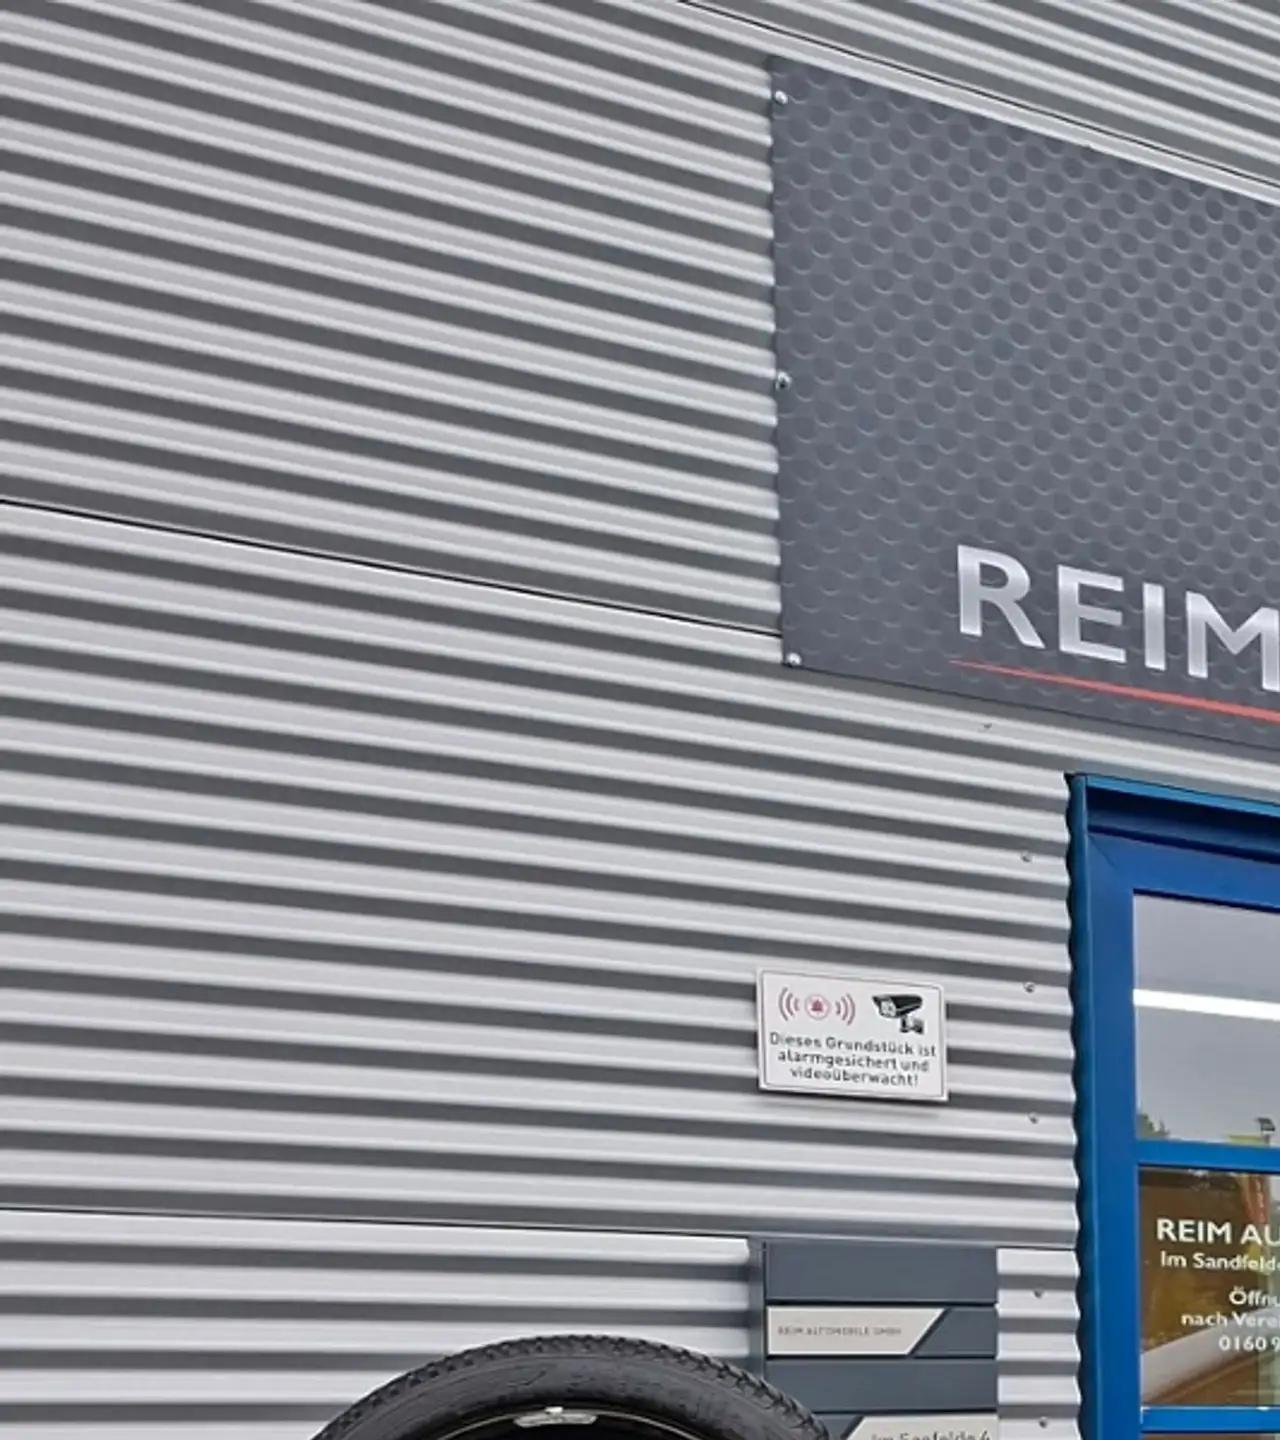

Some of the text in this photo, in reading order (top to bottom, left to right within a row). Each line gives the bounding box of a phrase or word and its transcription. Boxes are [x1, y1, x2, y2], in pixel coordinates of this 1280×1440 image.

[769, 1031, 937, 1058] Dieses Grundstück ist
[777, 1050, 930, 1073] alarmgesichert und
[790, 1066, 919, 1087] videoüberwacht!
[1156, 1217, 1233, 1245] REIM
[1160, 1250, 1188, 1268] Im
[1181, 1311, 1228, 1328] nach
[1218, 1335, 1267, 1352] 0160
